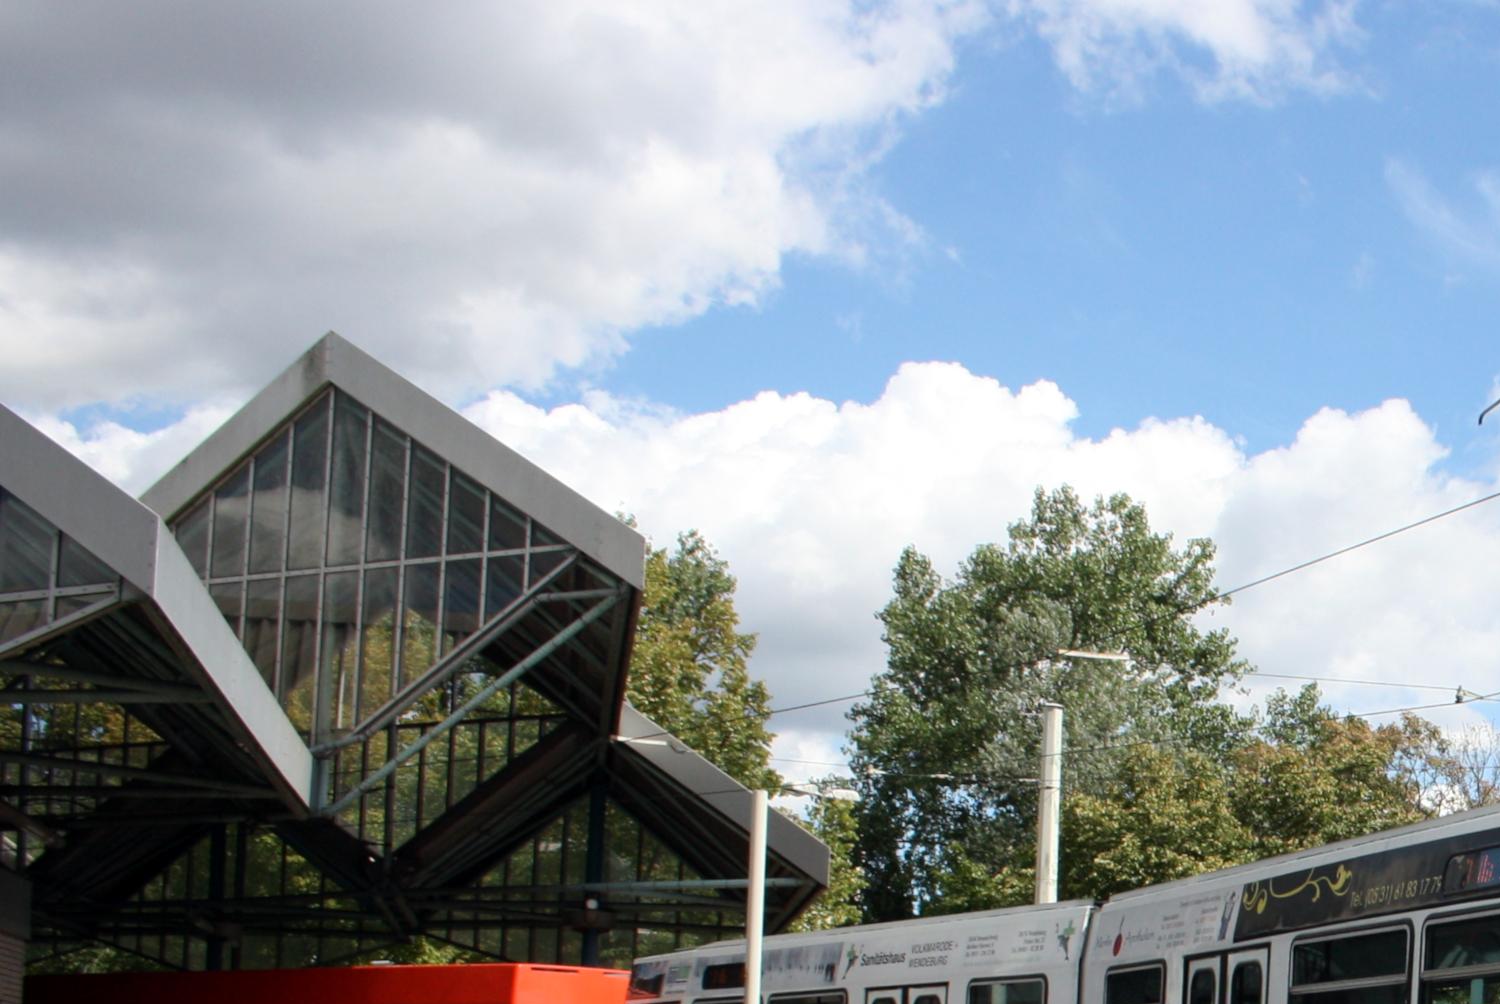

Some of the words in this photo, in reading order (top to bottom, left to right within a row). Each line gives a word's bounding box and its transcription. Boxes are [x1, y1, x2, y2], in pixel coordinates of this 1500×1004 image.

[1406, 879, 1418, 898] 83
[860, 951, 906, 967] Sanitätshaus
[908, 955, 949, 969] WENDEBURG
